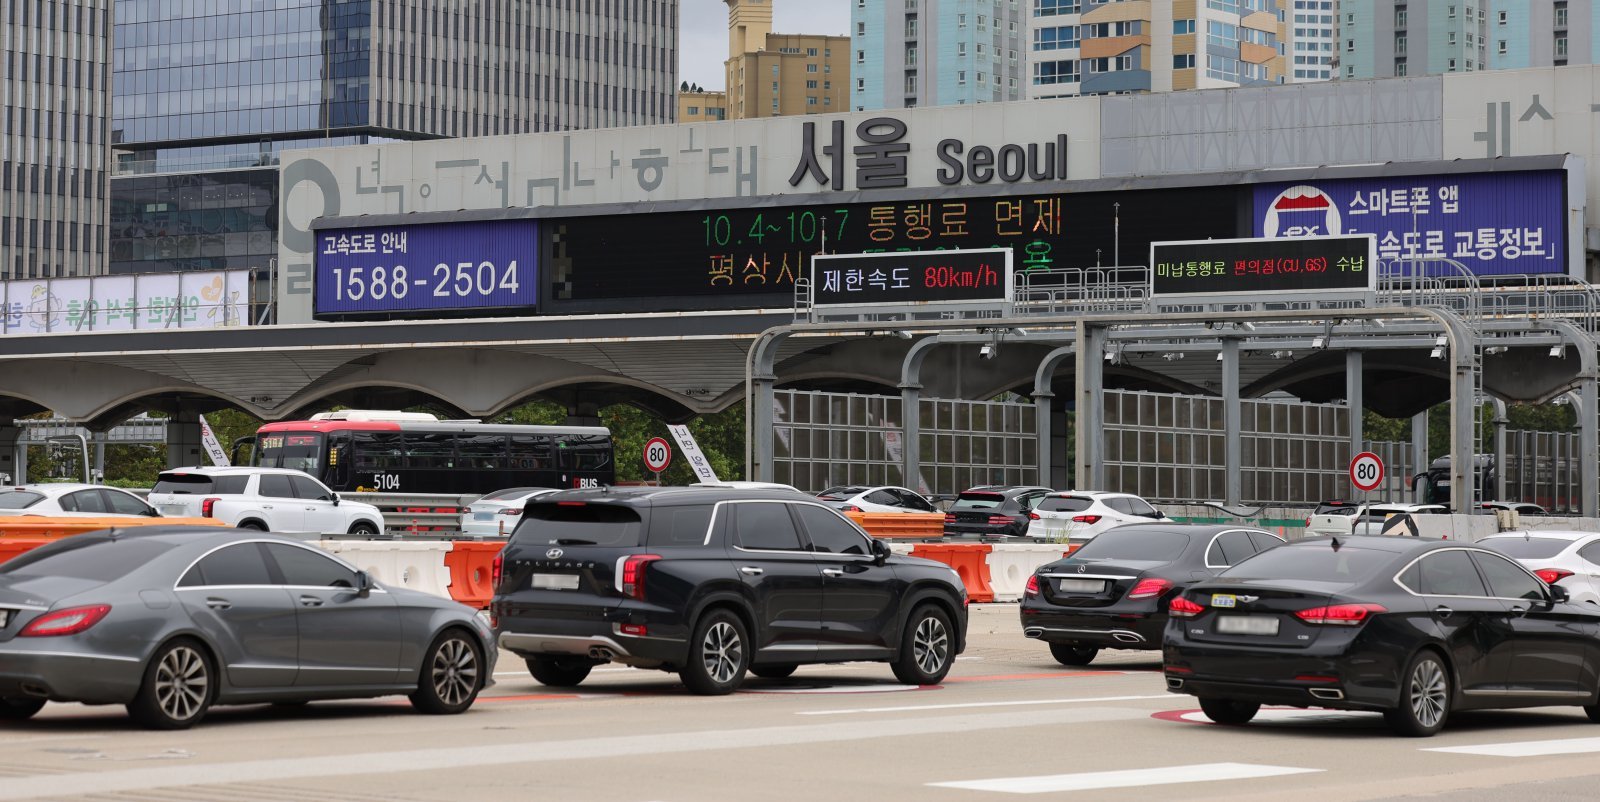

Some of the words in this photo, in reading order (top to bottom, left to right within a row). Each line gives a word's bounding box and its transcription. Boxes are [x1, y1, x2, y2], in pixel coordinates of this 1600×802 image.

[788, 117, 910, 191] 서울
[936, 133, 1068, 186] Seoul
[1349, 187, 1430, 216] 스마트폰
[1438, 185, 1459, 214] 앱
[867, 203, 969, 242] 통행료
[995, 196, 1061, 236] 면제
[324, 234, 376, 255] 고속도로
[381, 231, 407, 254] 안내
[333, 260, 519, 301] 1588-2504
[822, 267, 911, 293] 제한속도
[925, 263, 997, 289] 80km/h
[1157, 261, 1226, 278] 미납통행료
[1234, 256, 1328, 277] 편의점(CU,GS)
[1336, 256, 1364, 272] 수납
[650, 447, 665, 462] 80
[374, 474, 400, 489] 5104
[1357, 463, 1376, 480] 80
